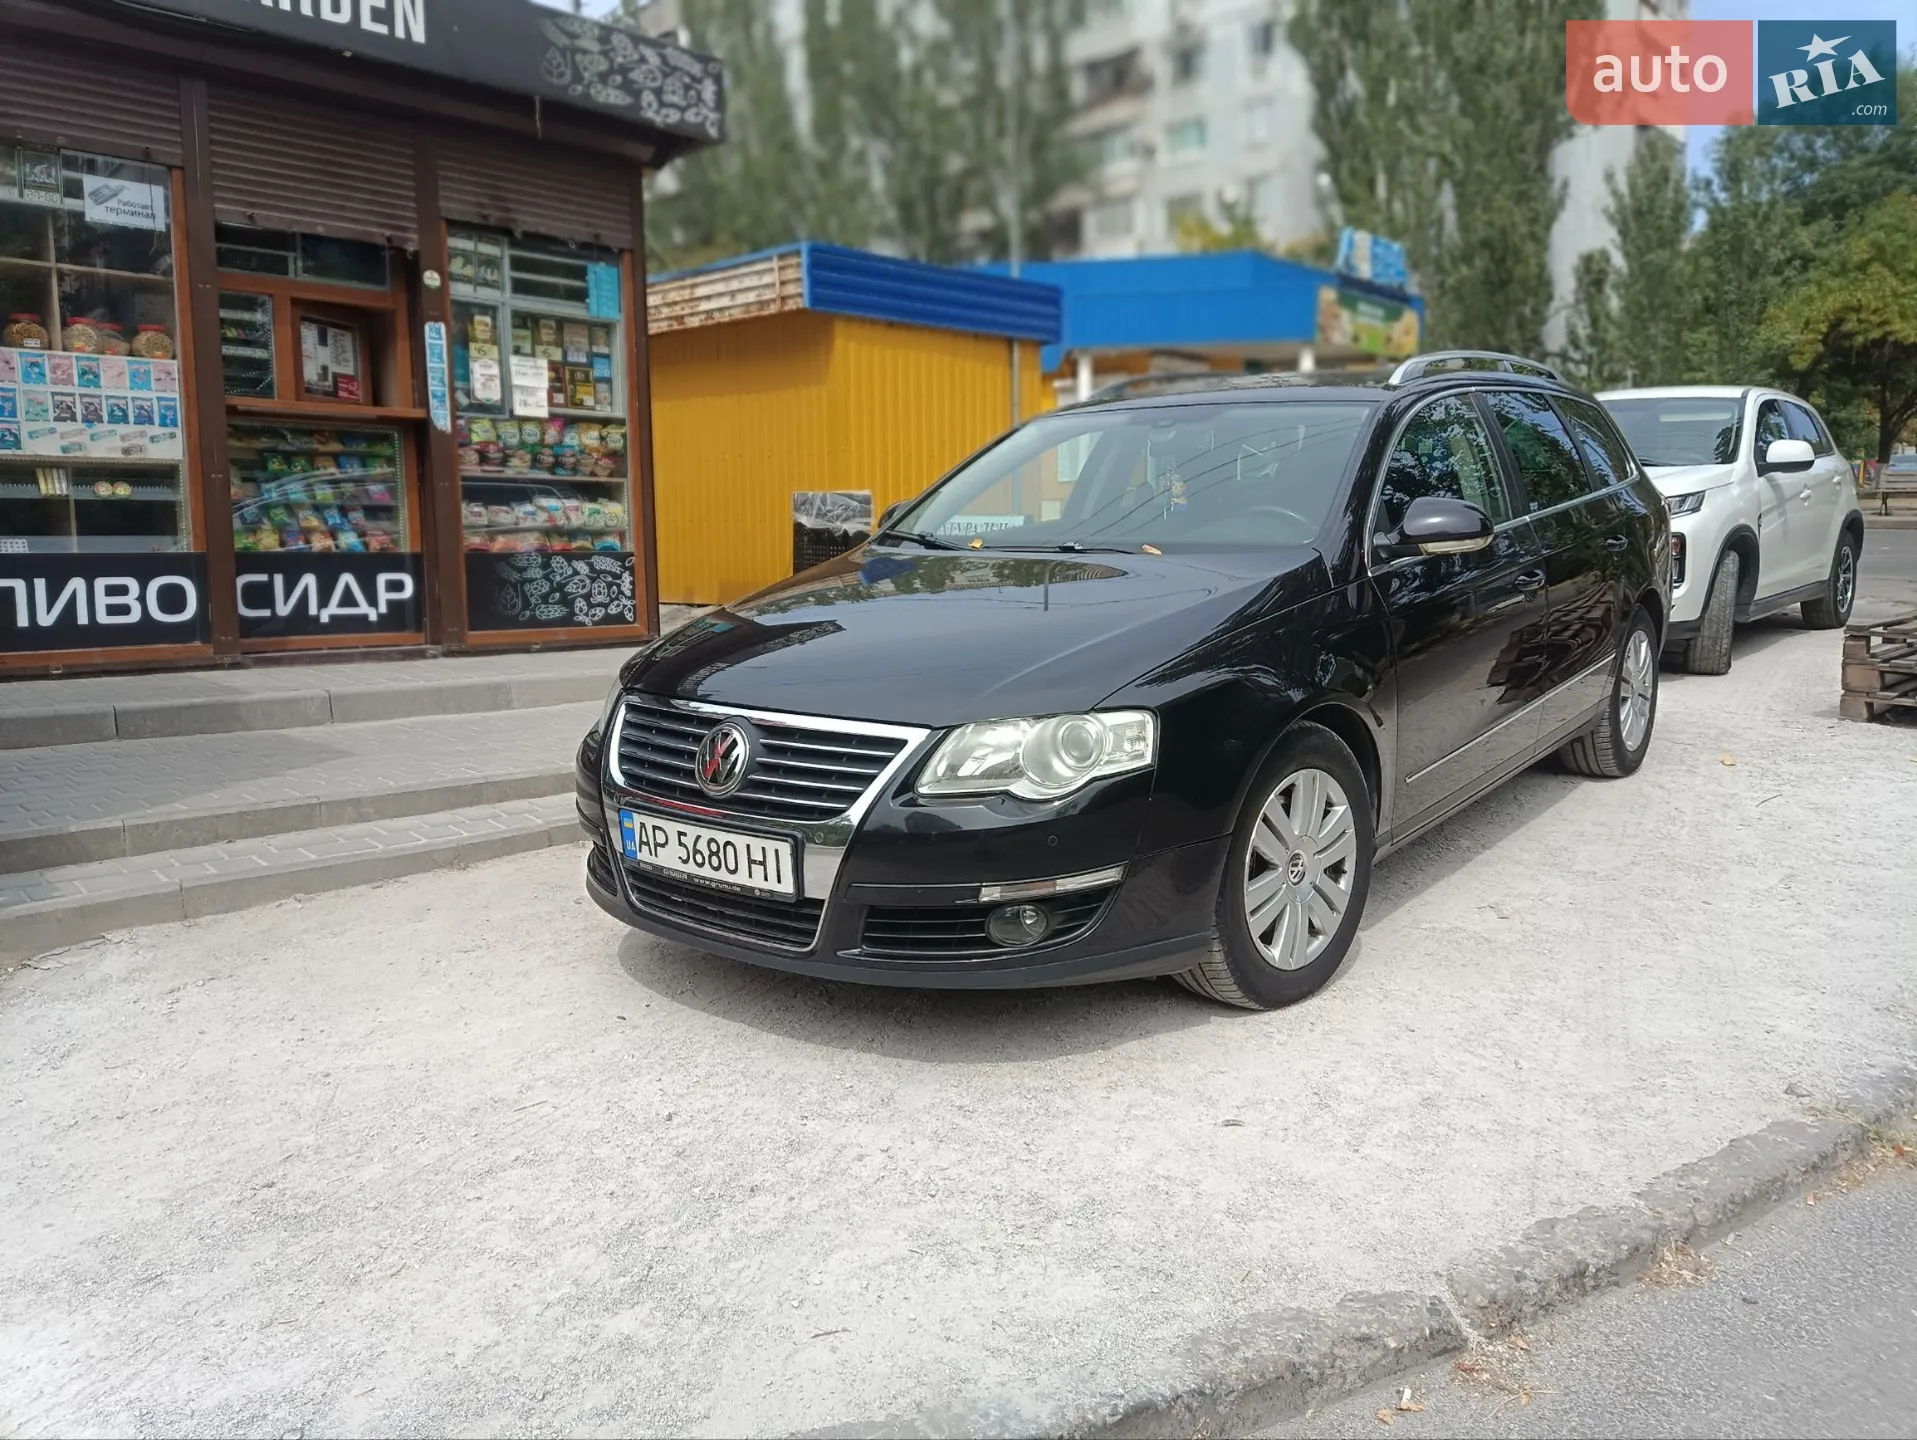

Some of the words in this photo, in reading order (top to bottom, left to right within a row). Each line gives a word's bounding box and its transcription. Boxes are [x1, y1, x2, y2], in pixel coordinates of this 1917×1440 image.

[104, 206, 156, 219] терминал
[235, 572, 413, 623] СИДР
[626, 839, 636, 851] UA
[638, 821, 669, 858] AP
[677, 830, 739, 875] 5680
[746, 843, 782, 884] HI
